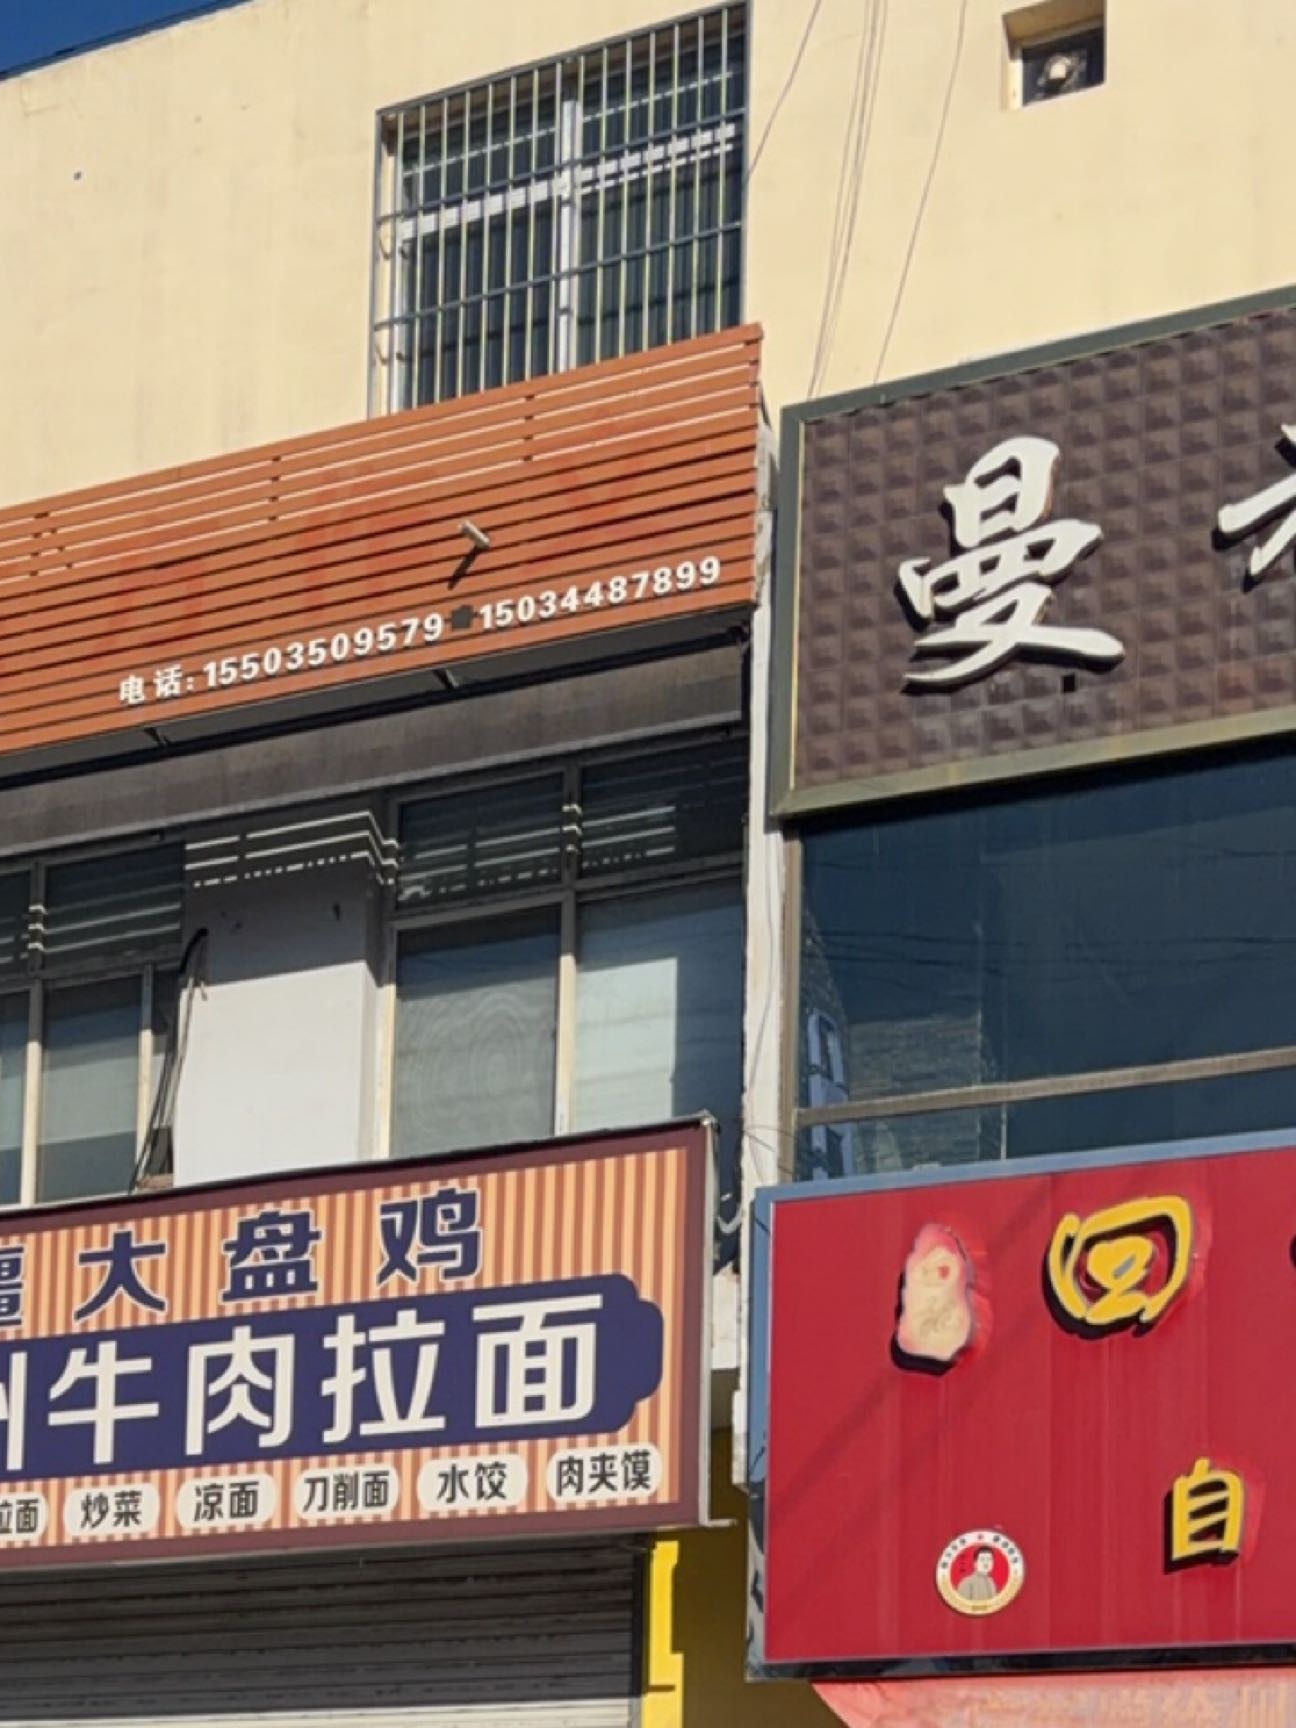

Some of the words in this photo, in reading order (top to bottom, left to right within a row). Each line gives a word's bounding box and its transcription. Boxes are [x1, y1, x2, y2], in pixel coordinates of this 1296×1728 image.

[202, 612, 444, 688] 15503509579
[479, 555, 722, 630] 15034487899
[80, 1490, 142, 1529] 炒菜
[194, 1480, 259, 1522] 凉面
[303, 1470, 390, 1512] 刀削面
[436, 1461, 508, 1503] 水饺
[555, 1449, 651, 1496] 肉夹馍
[1170, 1458, 1245, 1562] 自
